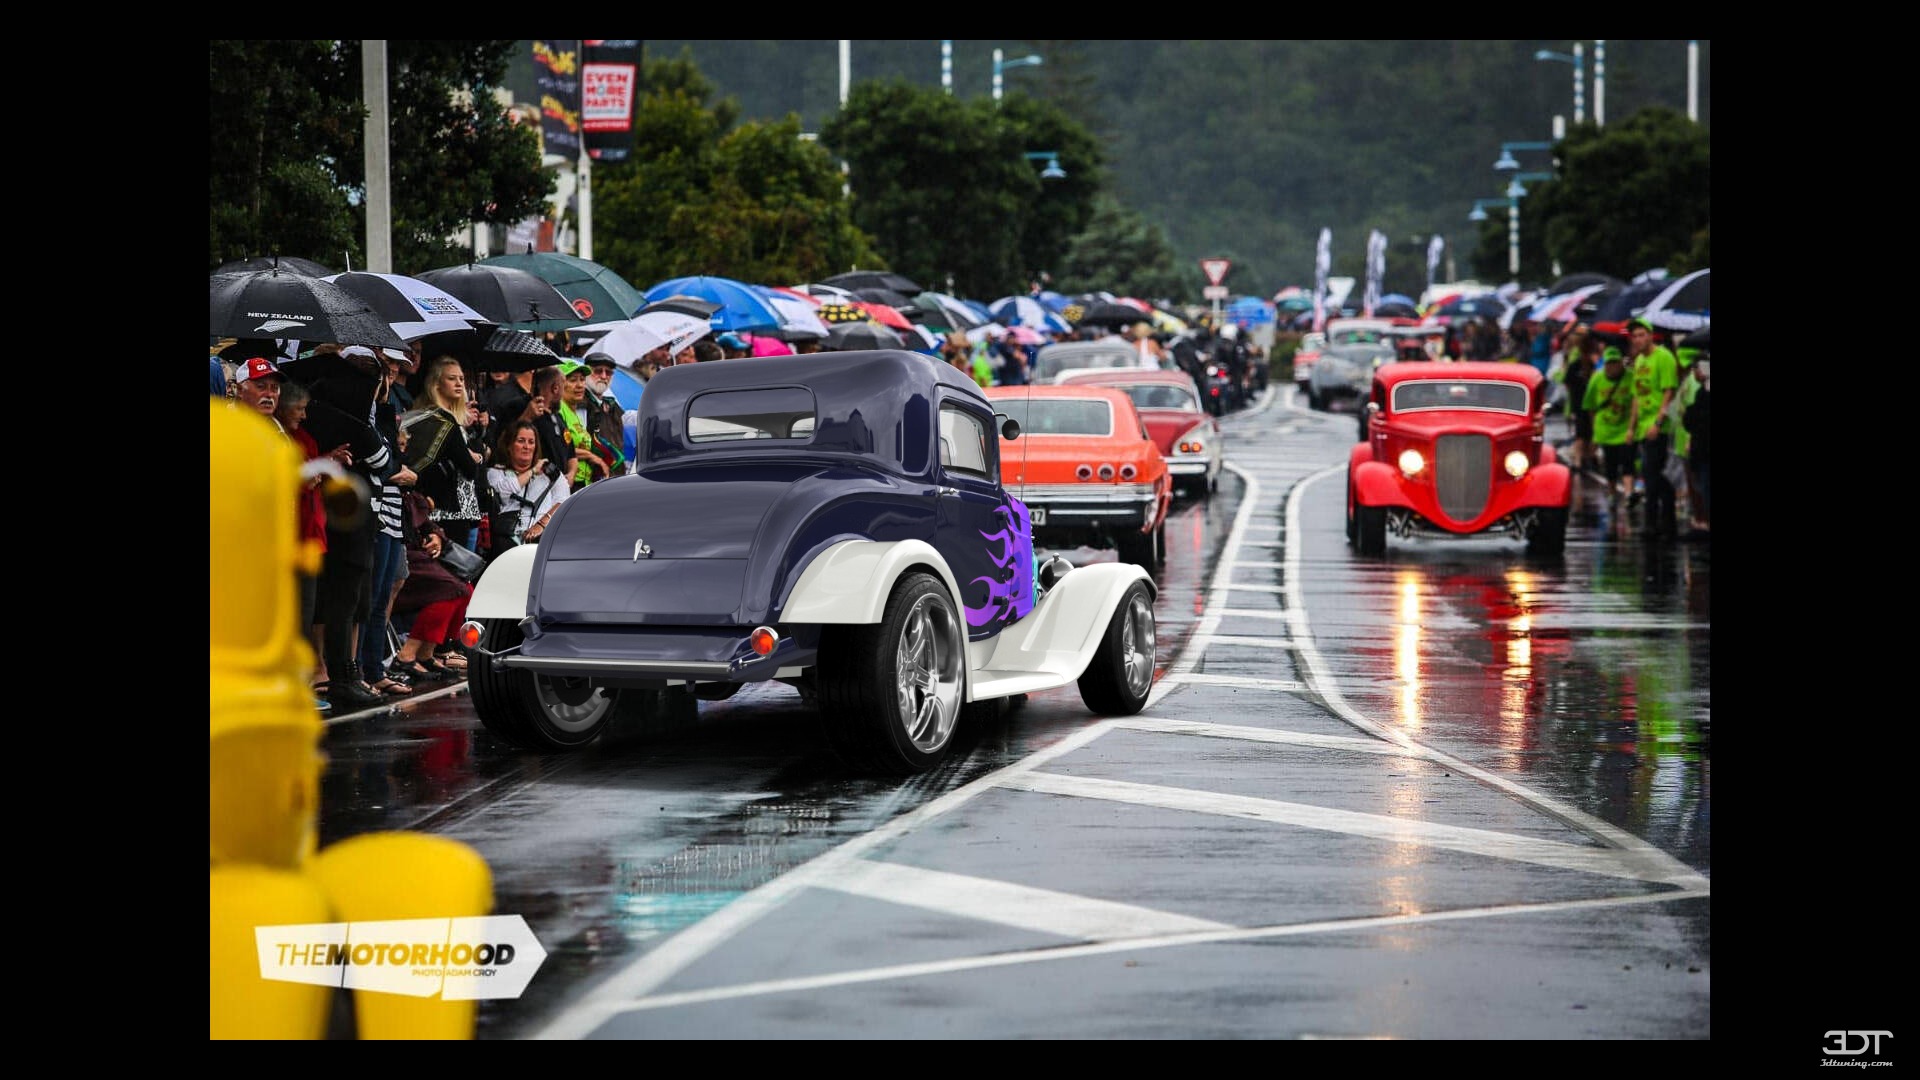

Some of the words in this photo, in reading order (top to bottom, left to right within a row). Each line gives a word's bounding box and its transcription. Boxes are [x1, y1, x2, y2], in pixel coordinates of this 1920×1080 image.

[586, 73, 628, 82] EVEN
[586, 84, 626, 96] MORE
[585, 98, 625, 108] PARTS
[270, 313, 314, 321] ZEALAND
